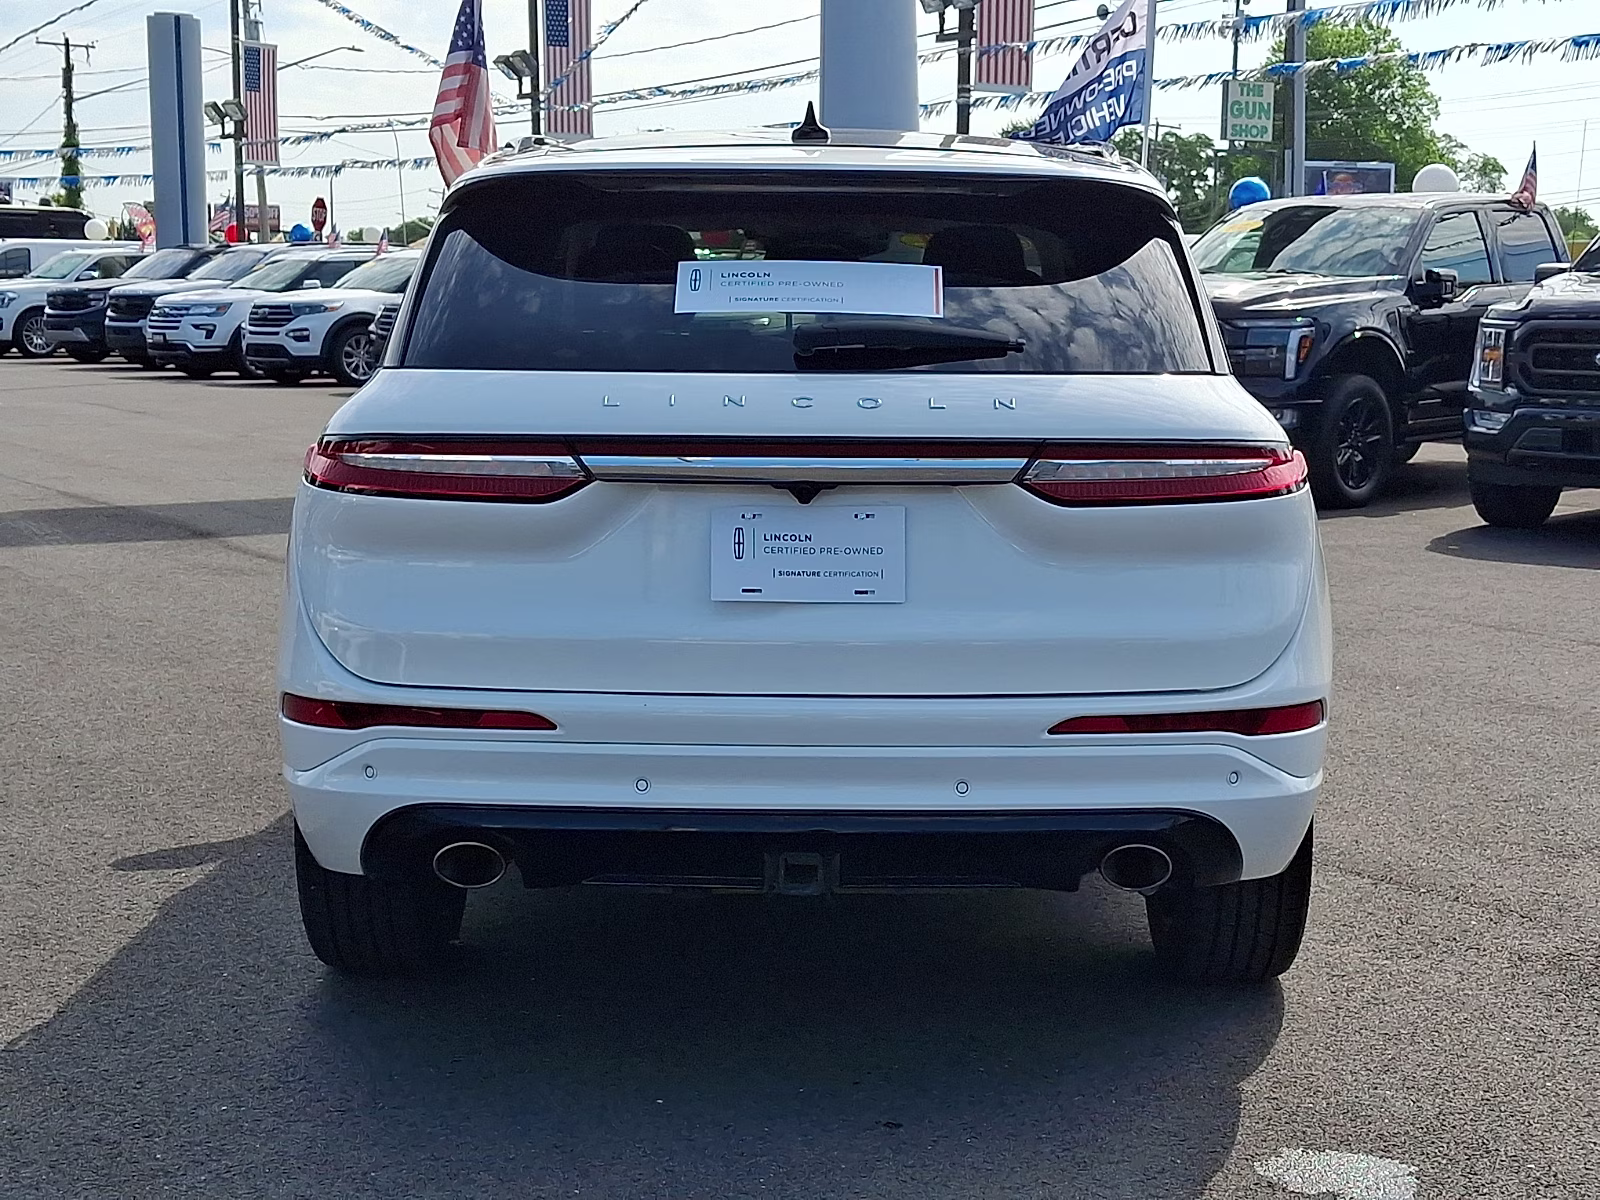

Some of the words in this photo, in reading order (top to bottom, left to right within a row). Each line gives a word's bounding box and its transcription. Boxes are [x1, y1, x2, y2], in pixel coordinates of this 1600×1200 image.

[1238, 83, 1264, 98] THE
[1229, 100, 1271, 121] GUN
[1230, 124, 1269, 139] SHOP
[312, 207, 327, 221] STOP
[720, 271, 772, 279] LINCOLN
[778, 280, 844, 288] PRE-OWNED
[602, 393, 1017, 411] LINCOLN
[763, 533, 813, 543] LINCOLN
[763, 546, 817, 556] CERTIFIED
[819, 546, 885, 556] PRE-OWNED
[777, 569, 822, 578] SIGNATURE
[823, 570, 880, 579] CERTIFICATION
